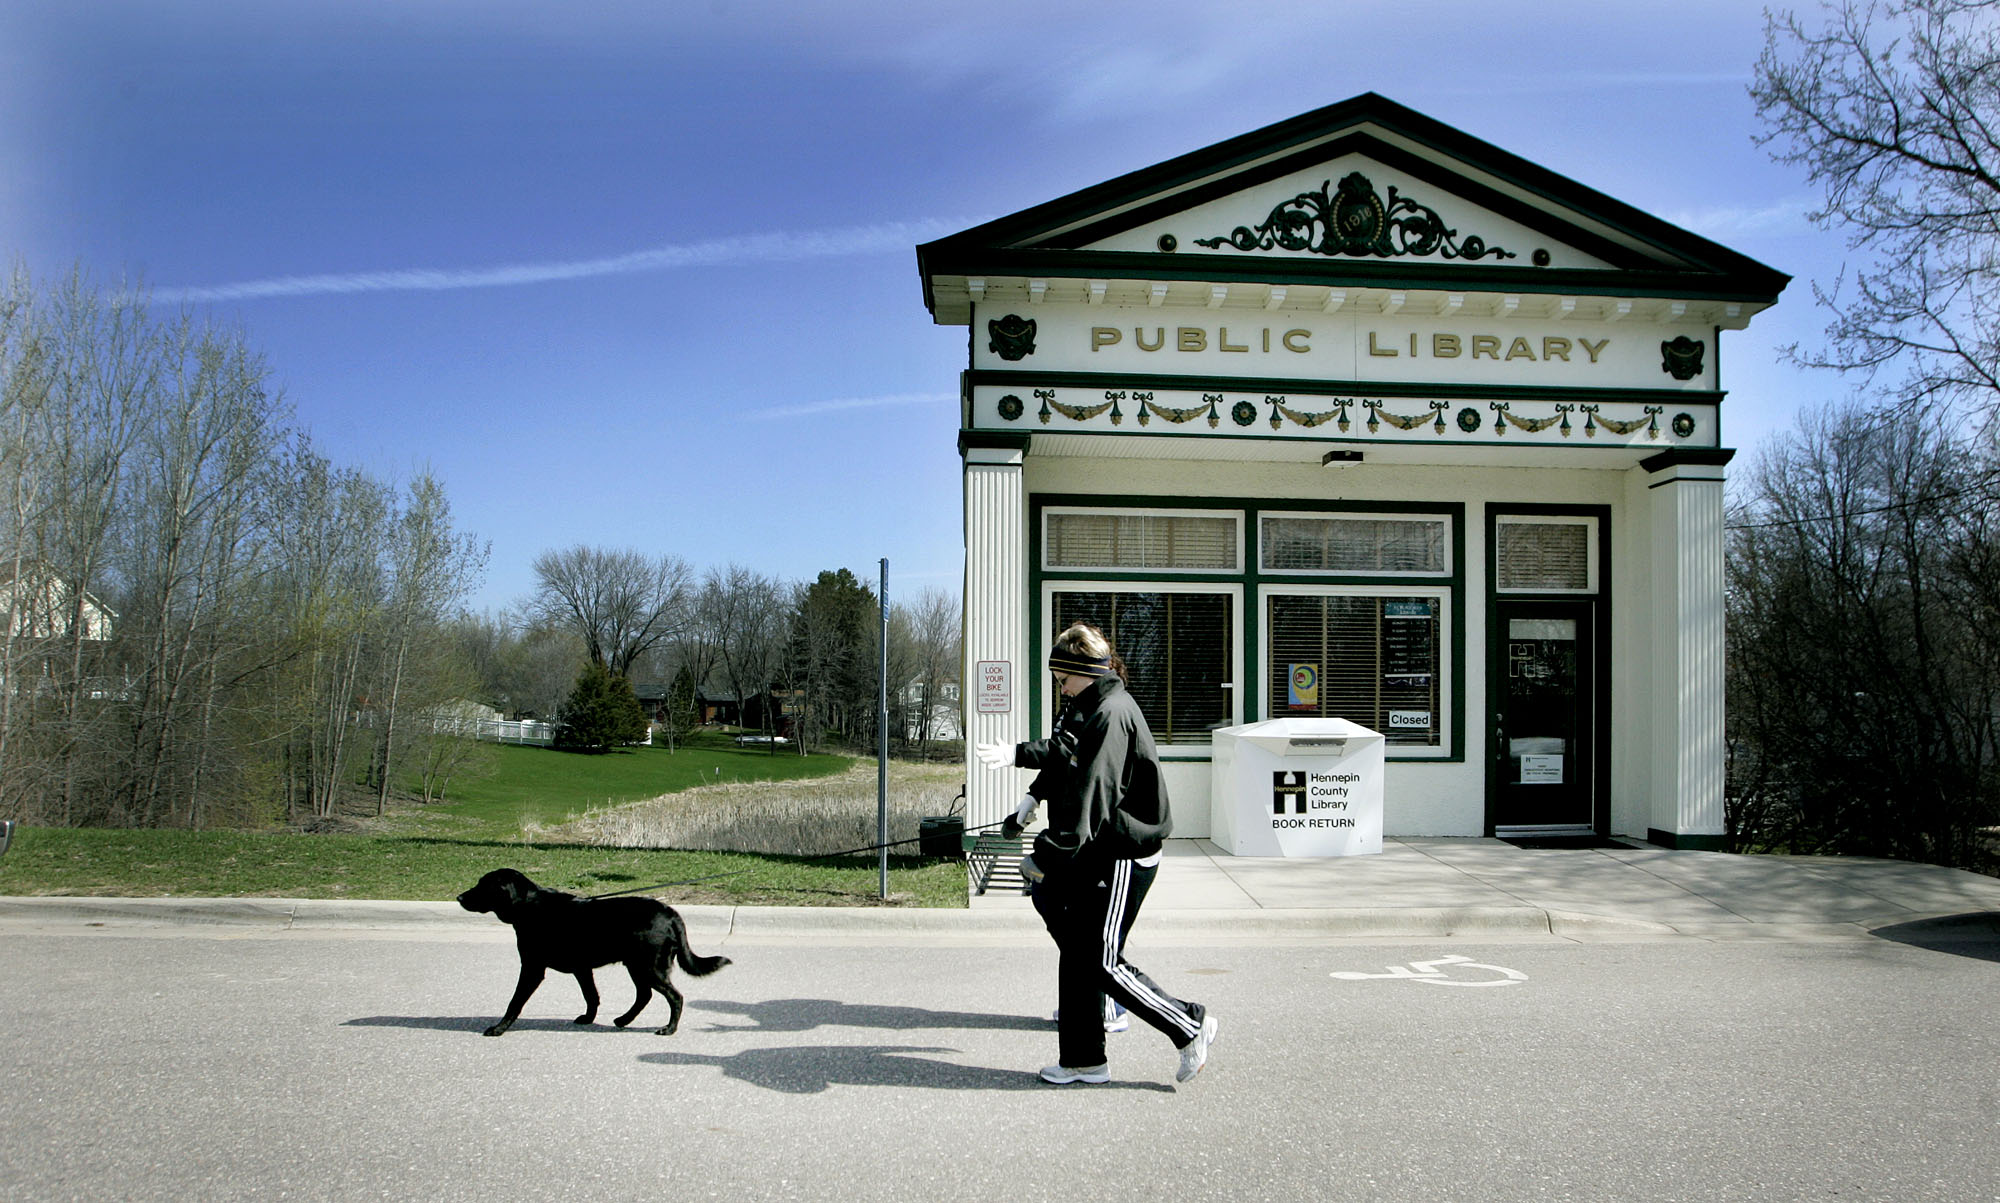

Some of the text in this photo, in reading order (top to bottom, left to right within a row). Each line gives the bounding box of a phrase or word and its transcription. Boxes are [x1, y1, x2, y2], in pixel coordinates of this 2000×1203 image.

[1091, 327, 1610, 363] PUBLIC LIBRARY
[985, 675, 1004, 683] YOUR
[1391, 714, 1429, 725] Closed
[1311, 773, 1360, 784] Hennepin
[1274, 785, 1307, 793] Hennepin
[1311, 786, 1348, 797] County
[1311, 800, 1348, 811] Library
[1272, 818, 1355, 829] BOOK RETURN
